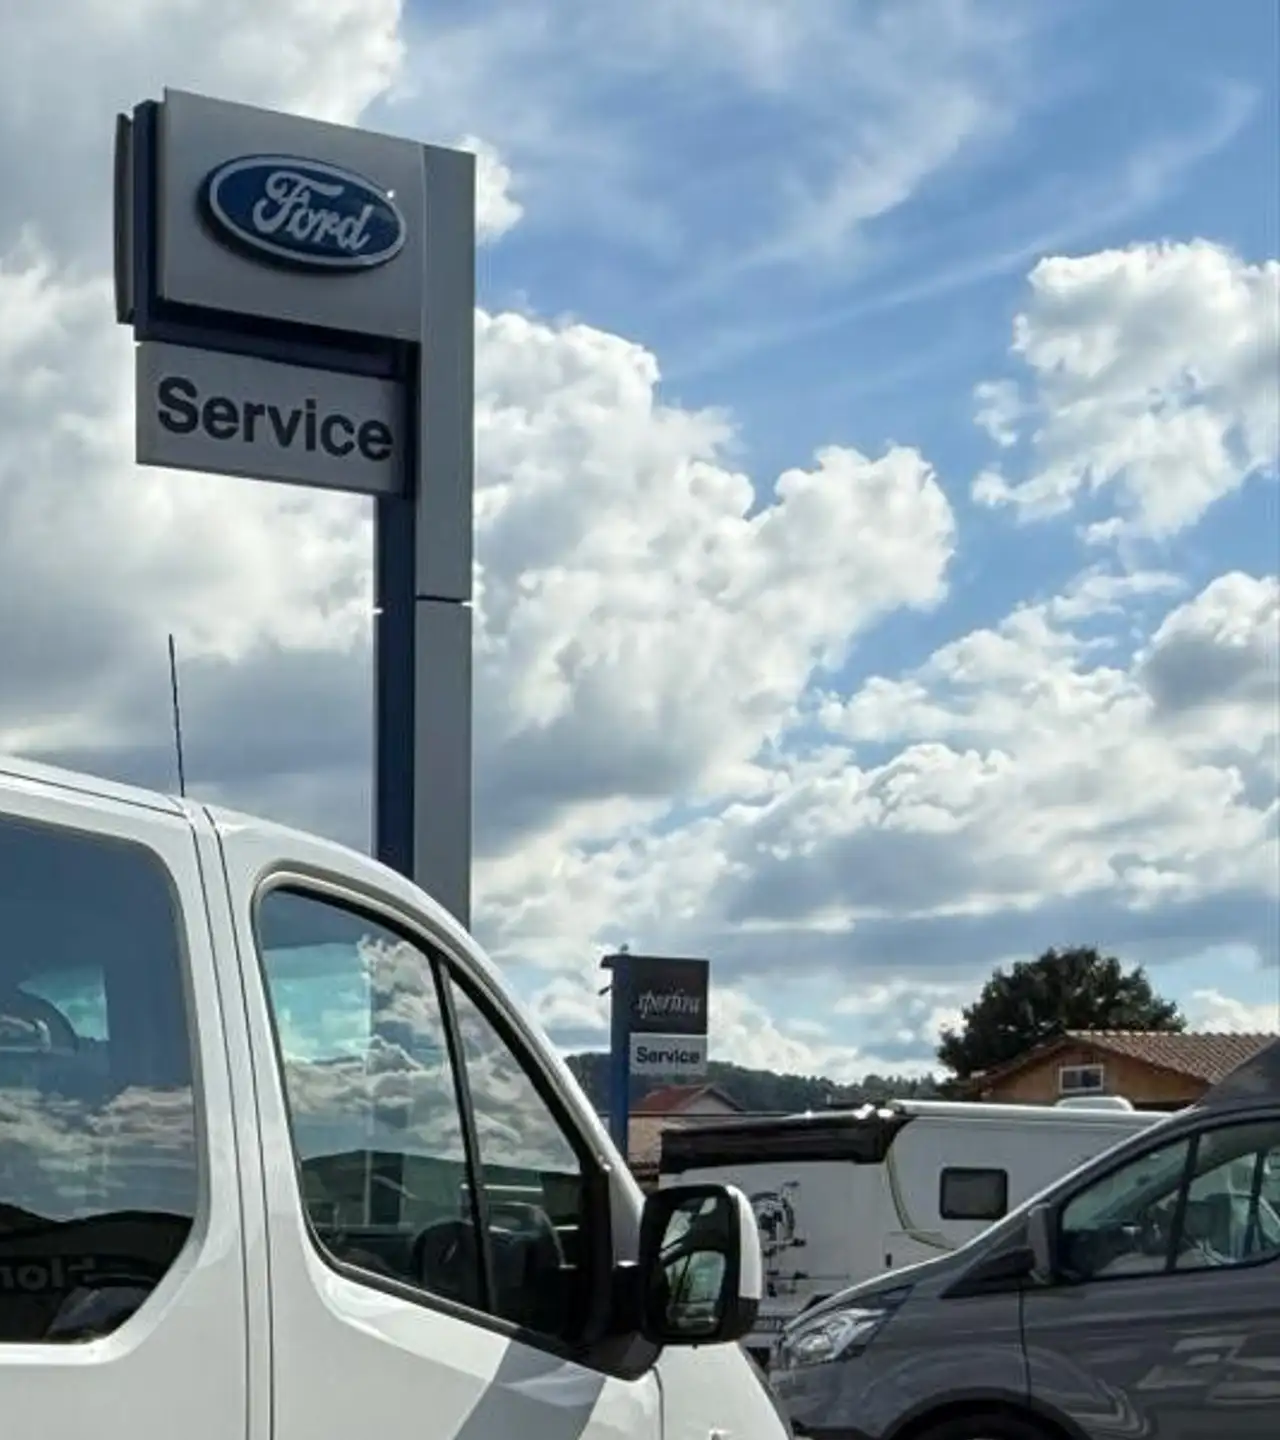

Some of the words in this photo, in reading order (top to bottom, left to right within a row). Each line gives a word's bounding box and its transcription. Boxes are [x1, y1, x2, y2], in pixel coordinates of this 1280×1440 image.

[252, 169, 374, 250] Ford
[157, 375, 394, 462] Service
[636, 1043, 701, 1065] Service
